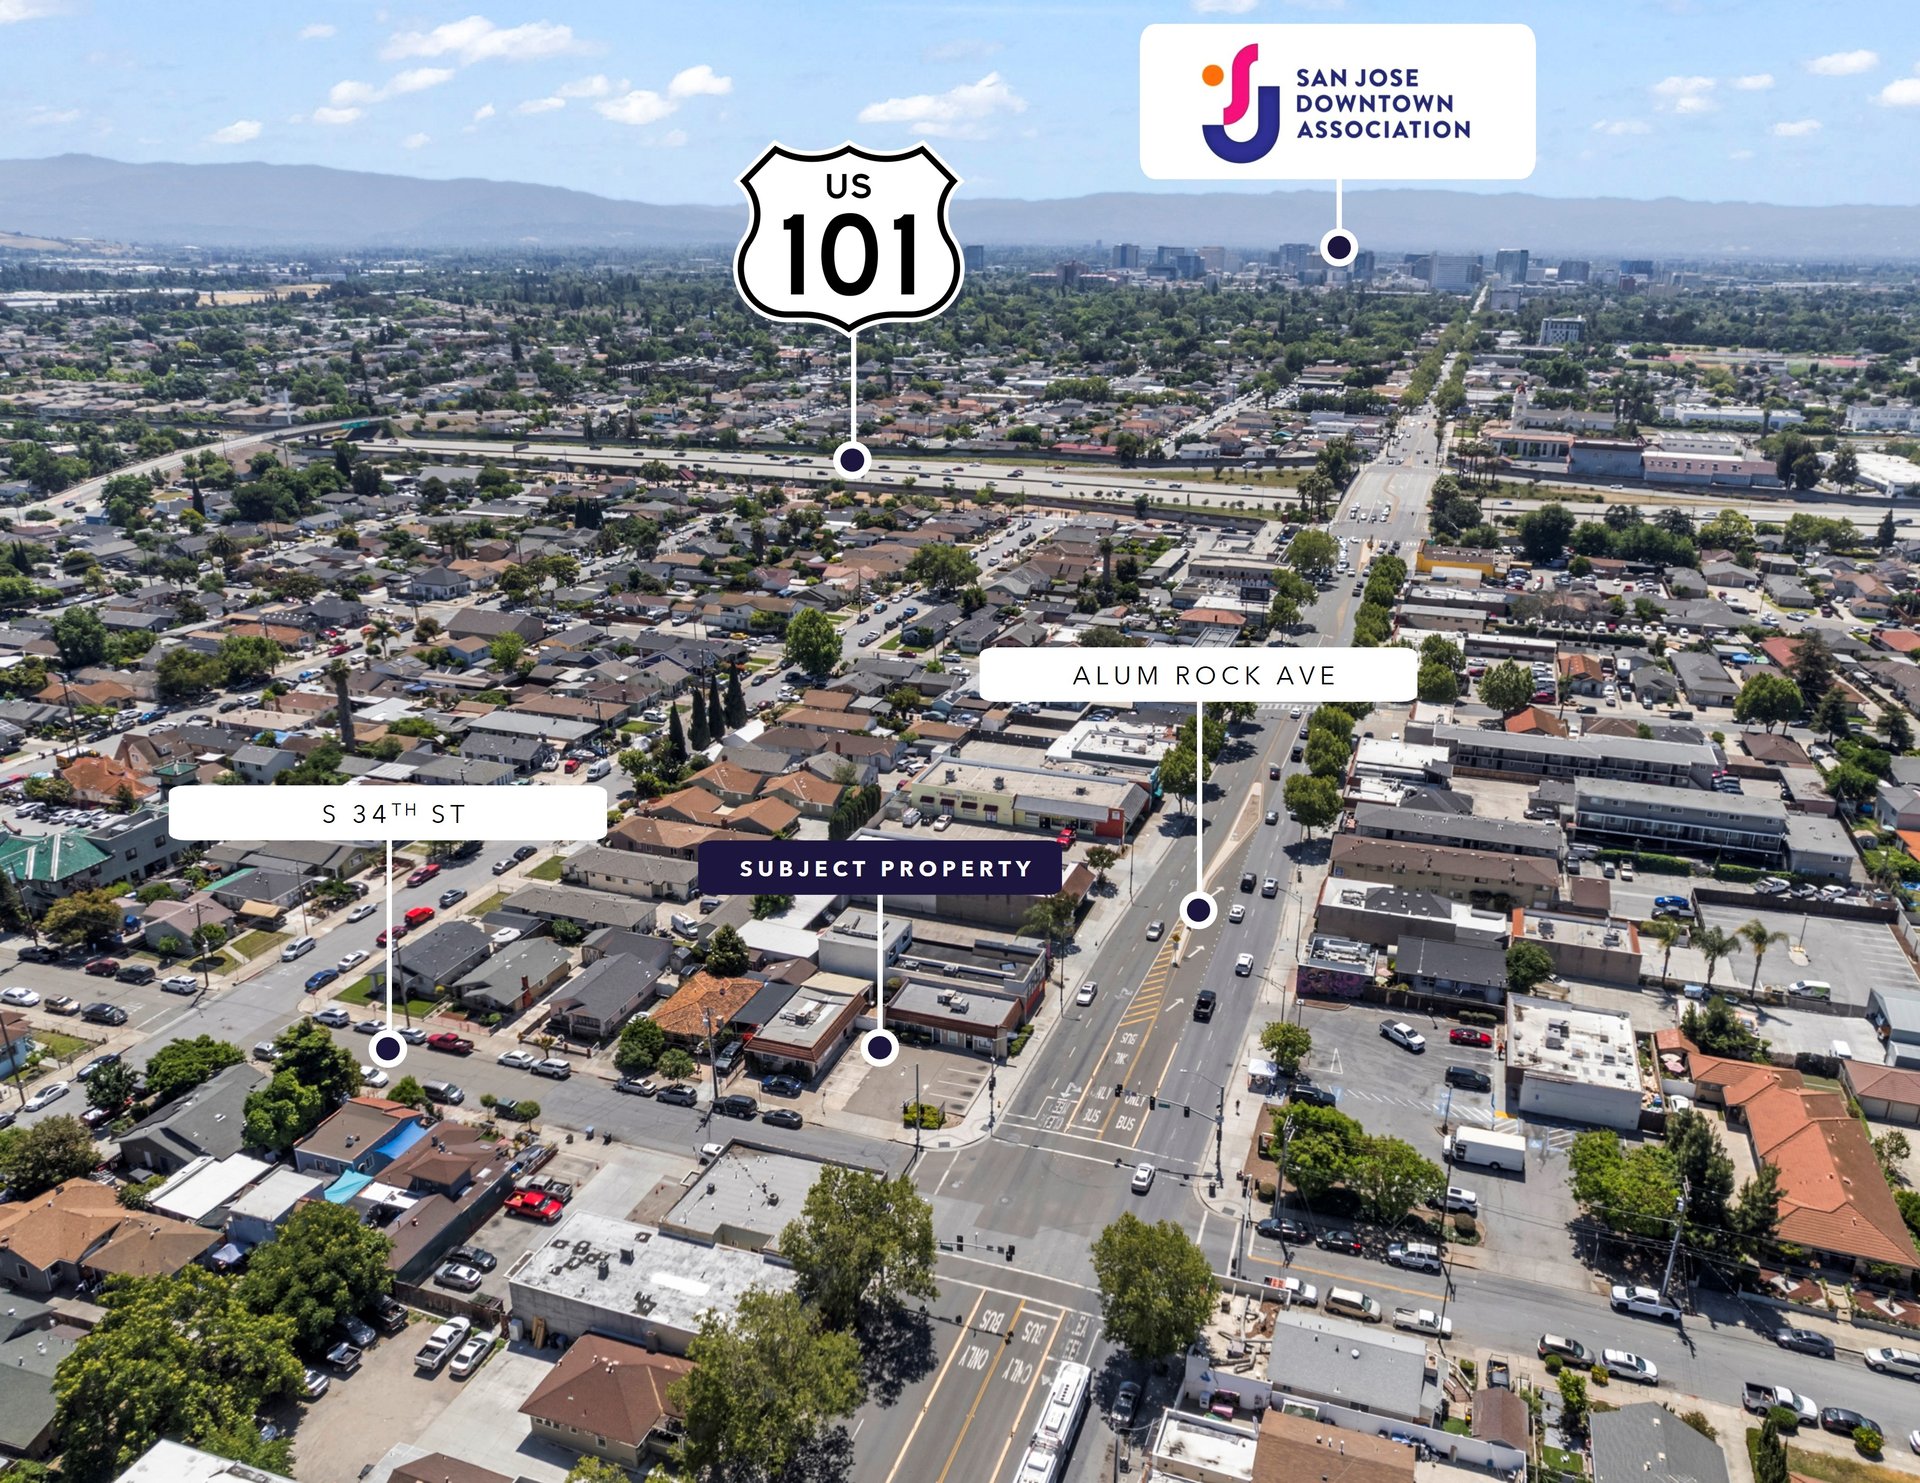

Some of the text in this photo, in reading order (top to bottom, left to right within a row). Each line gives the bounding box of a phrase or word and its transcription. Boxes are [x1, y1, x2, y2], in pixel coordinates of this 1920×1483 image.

[1115, 1115, 1136, 1131] BUS
[979, 1309, 1005, 1333] BUS
[1021, 1320, 1047, 1344] BUS
[958, 1344, 989, 1371] ONLY
[1002, 1357, 1033, 1384] ONLY
